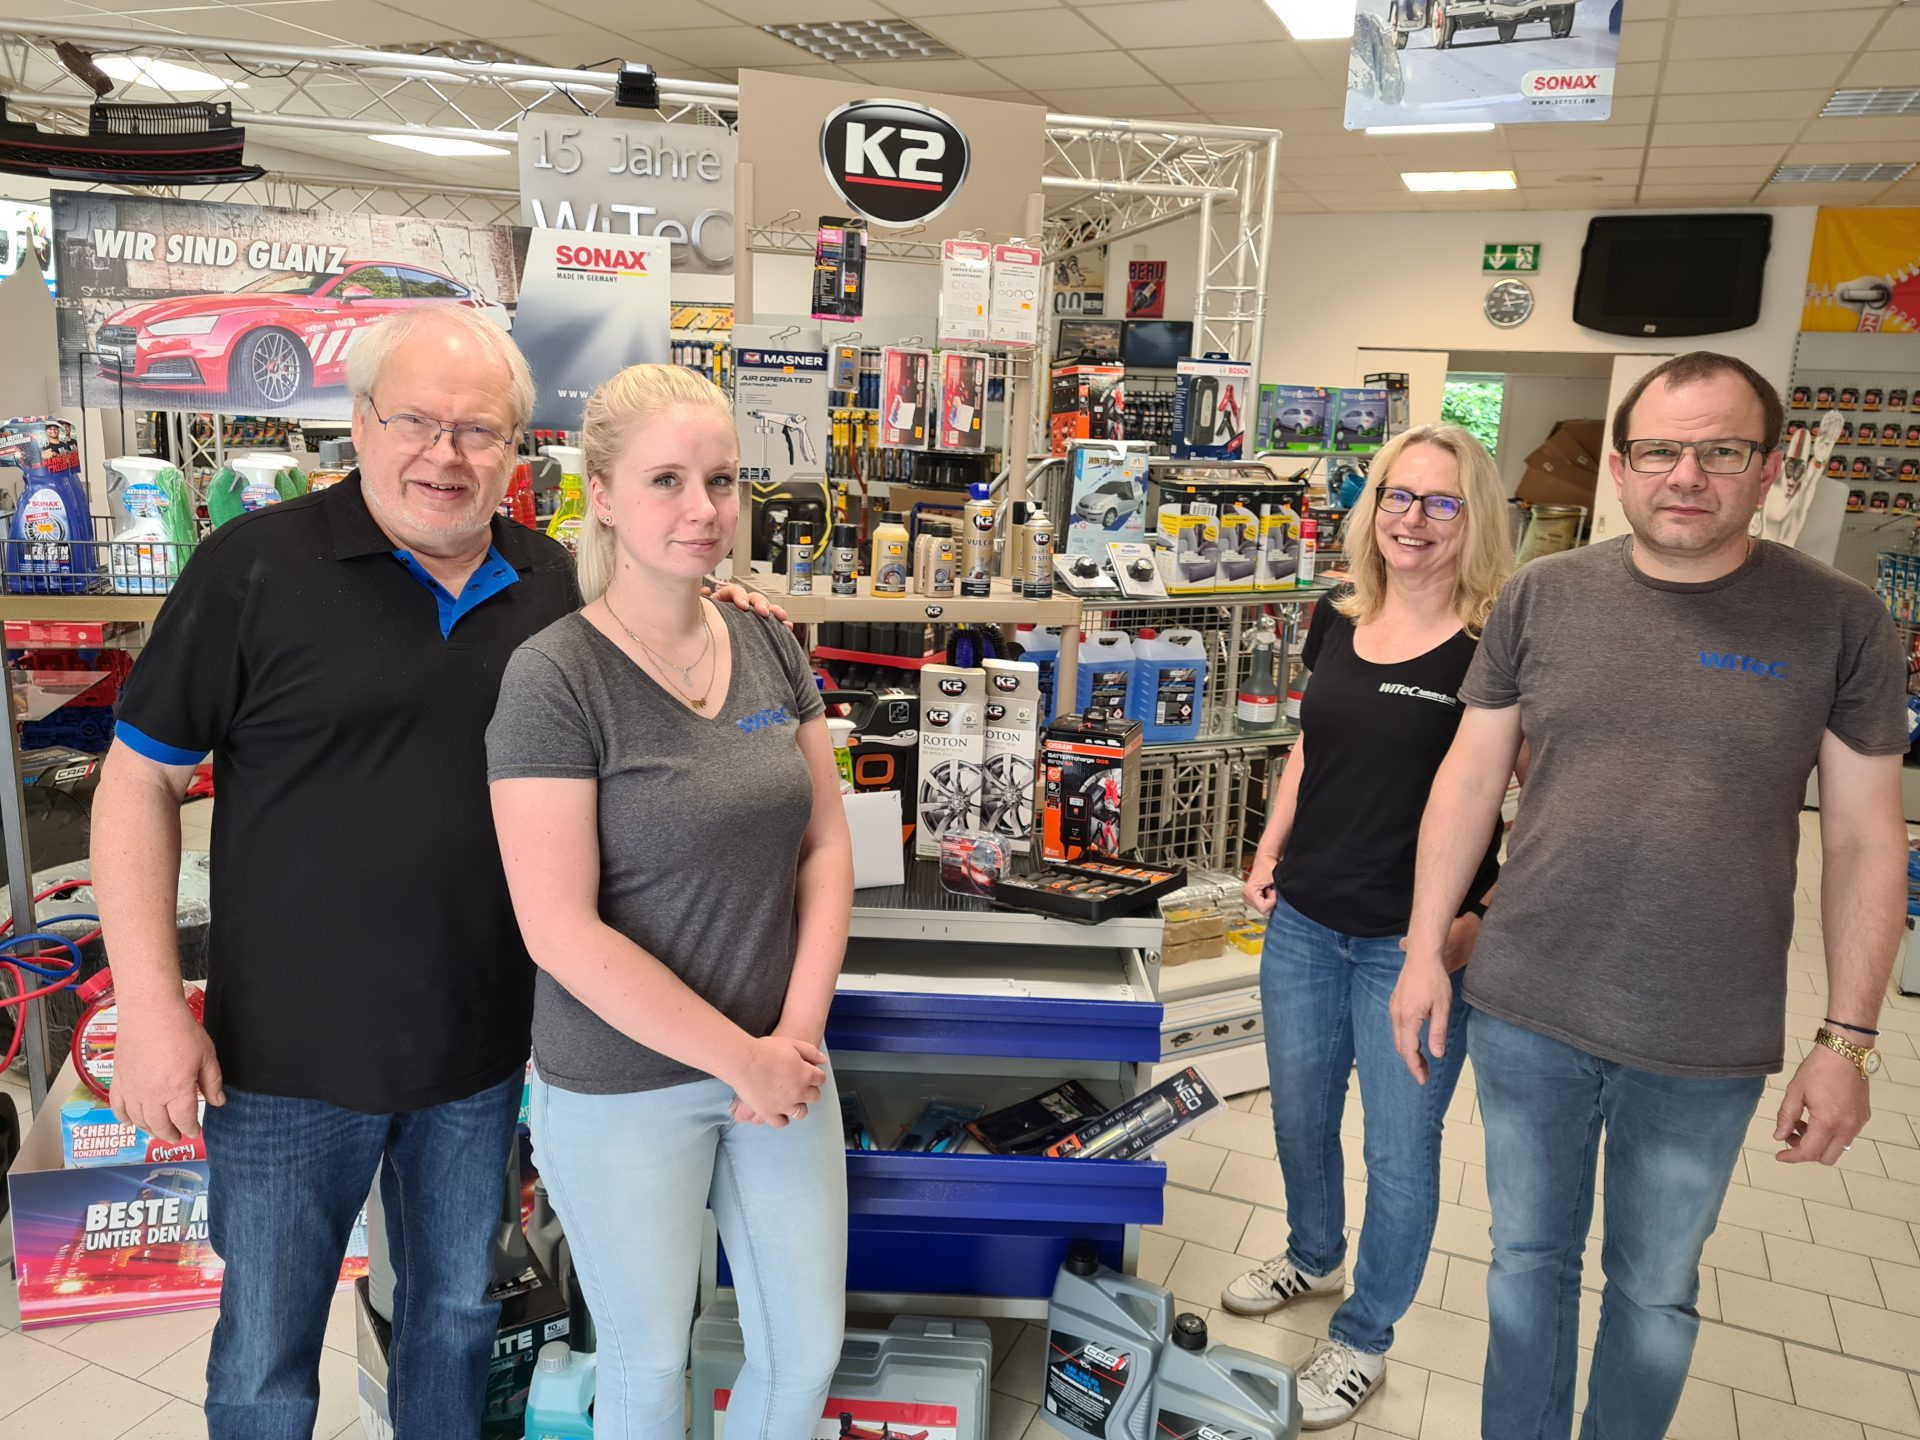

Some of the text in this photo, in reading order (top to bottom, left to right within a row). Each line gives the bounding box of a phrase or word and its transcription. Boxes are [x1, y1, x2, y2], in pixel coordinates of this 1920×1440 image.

[1533, 74, 1598, 91] SONAX
[531, 128, 722, 182] 15 Jahre
[844, 121, 946, 184] K2
[94, 228, 347, 275] WIR SIND GLANZ
[556, 244, 647, 272] SONAX
[556, 272, 618, 284] MADE IN GERMANY
[763, 353, 824, 367] MASNER
[1228, 366, 1249, 375] BOSCH
[740, 374, 813, 385] AIR OPERATED
[975, 515, 993, 526] K2
[1035, 534, 1050, 542] K2
[31, 545, 70, 556] FEGEN
[841, 553, 854, 561] K2
[926, 606, 943, 616] K2
[1699, 649, 1790, 681] WiTeC
[942, 680, 963, 692] K2
[996, 676, 1017, 688] K2
[929, 710, 951, 722] K2
[922, 734, 969, 748] ROTON
[1047, 743, 1073, 752] OSRAM
[1172, 1078, 1202, 1111] NEO
[1173, 1095, 1189, 1116] TOOLS
[72, 1123, 137, 1139] SCHEIBEN
[73, 1136, 137, 1151] REINIGER
[73, 1149, 119, 1159] KONZENTRAT
[151, 1143, 196, 1161] Cherry
[85, 1198, 181, 1232] BESTE
[86, 1221, 209, 1251] UNTER DEN AU
